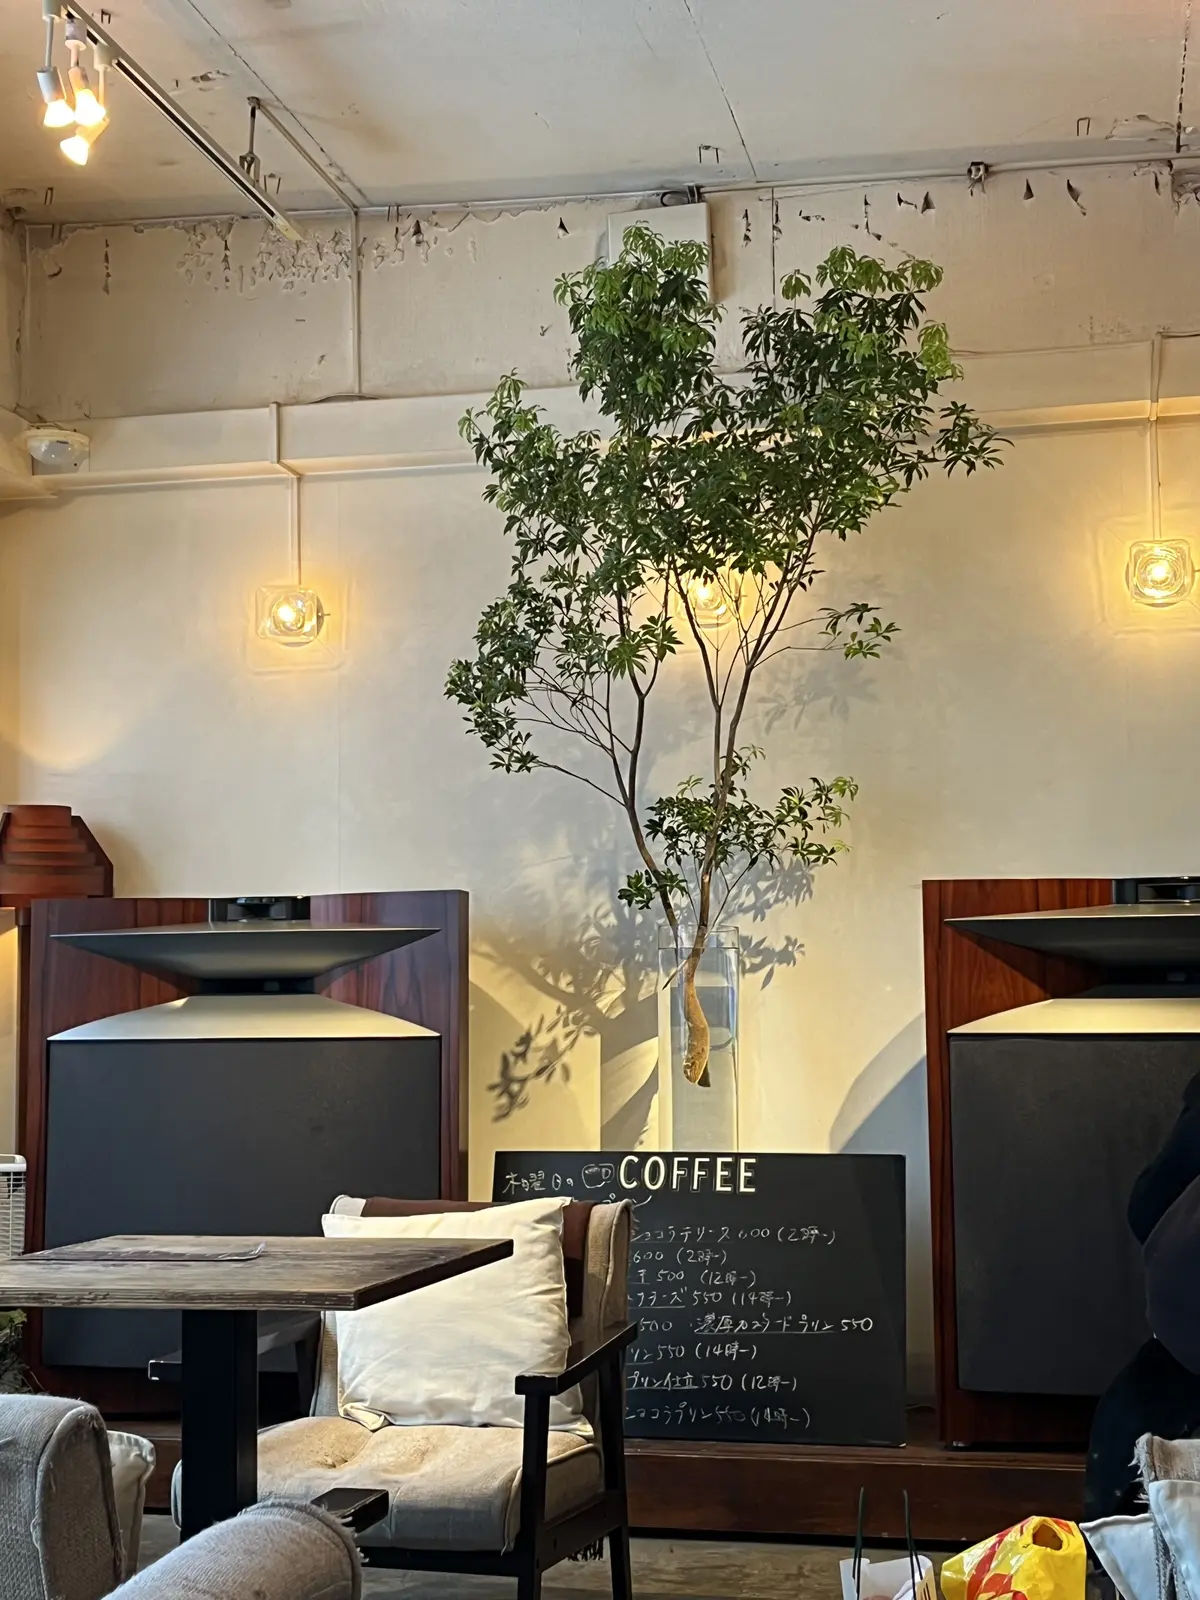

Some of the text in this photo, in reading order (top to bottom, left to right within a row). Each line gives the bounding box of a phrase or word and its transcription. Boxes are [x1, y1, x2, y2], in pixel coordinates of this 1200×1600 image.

[618, 1155, 758, 1194] COFFEE
[633, 1250, 664, 1264] 600
[656, 1269, 685, 1282] 500
[692, 1290, 722, 1306] 550
[640, 1317, 673, 1331] 500
[841, 1317, 873, 1331] 550
[656, 1345, 685, 1360] 550
[701, 1374, 733, 1390] 550
